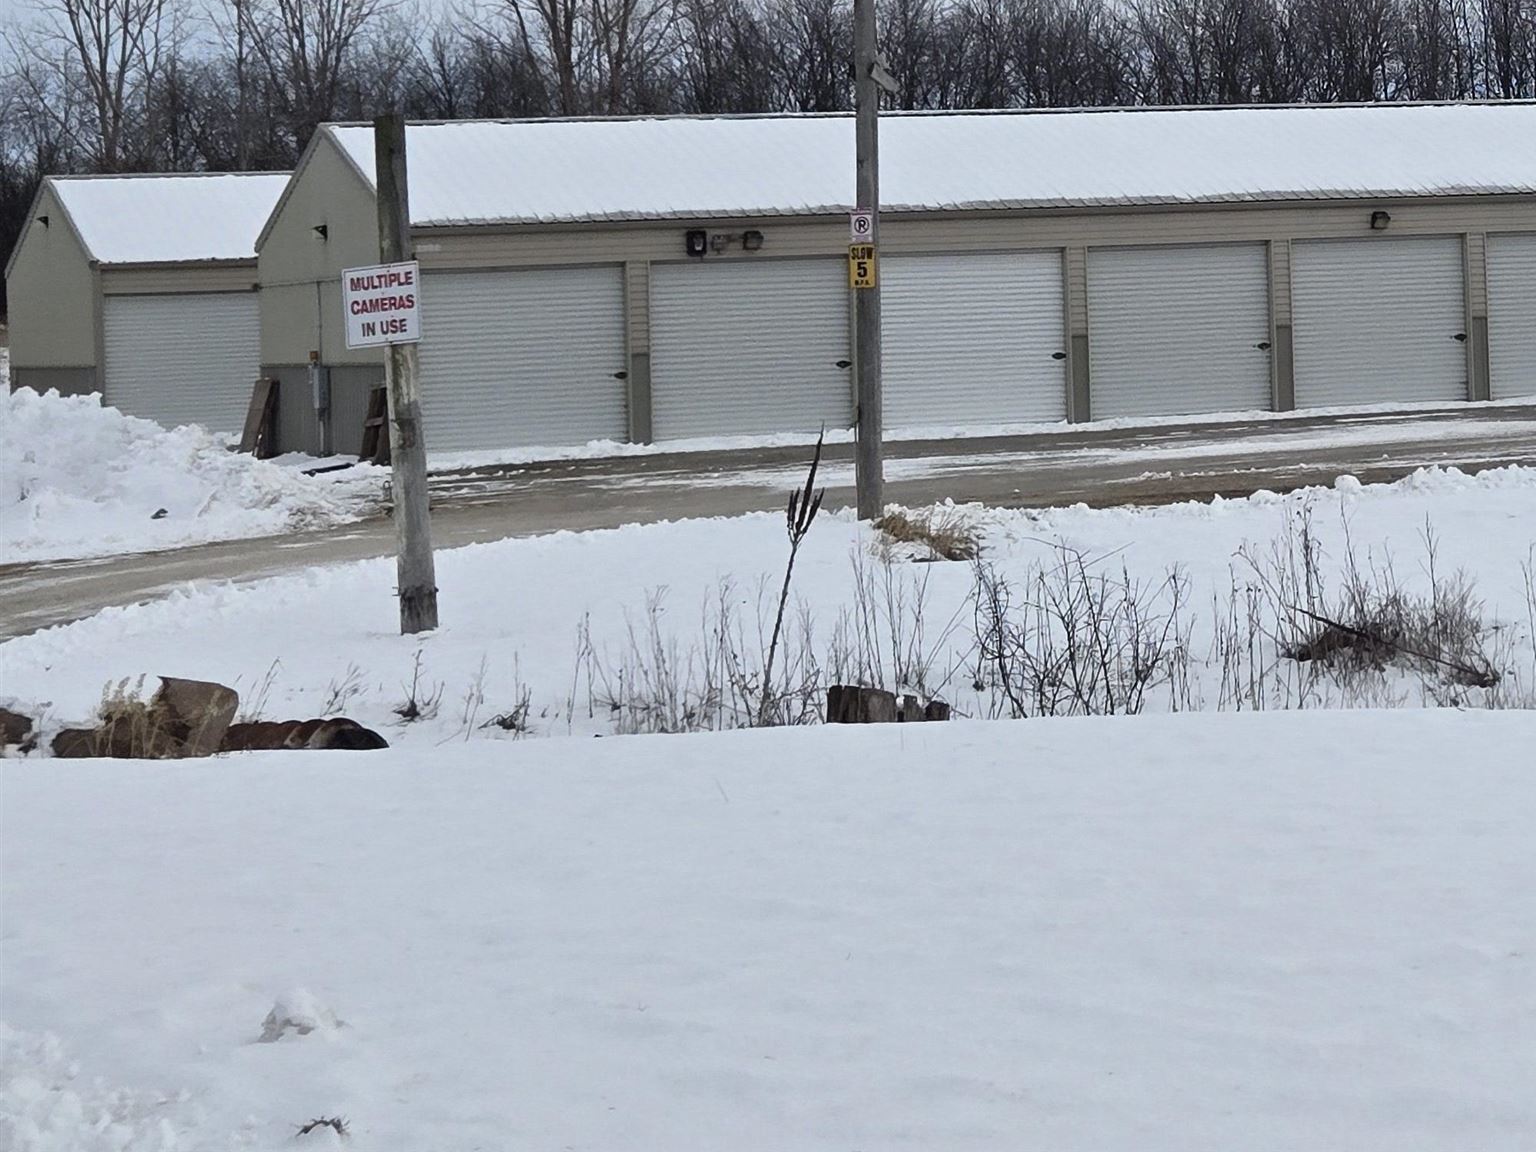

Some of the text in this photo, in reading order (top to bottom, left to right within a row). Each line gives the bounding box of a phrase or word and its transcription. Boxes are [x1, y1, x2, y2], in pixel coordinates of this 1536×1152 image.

[857, 261, 868, 278] 5
[350, 271, 414, 292] MULTIPLE
[350, 294, 415, 315] CAMERAS
[361, 318, 408, 337] IN USE
